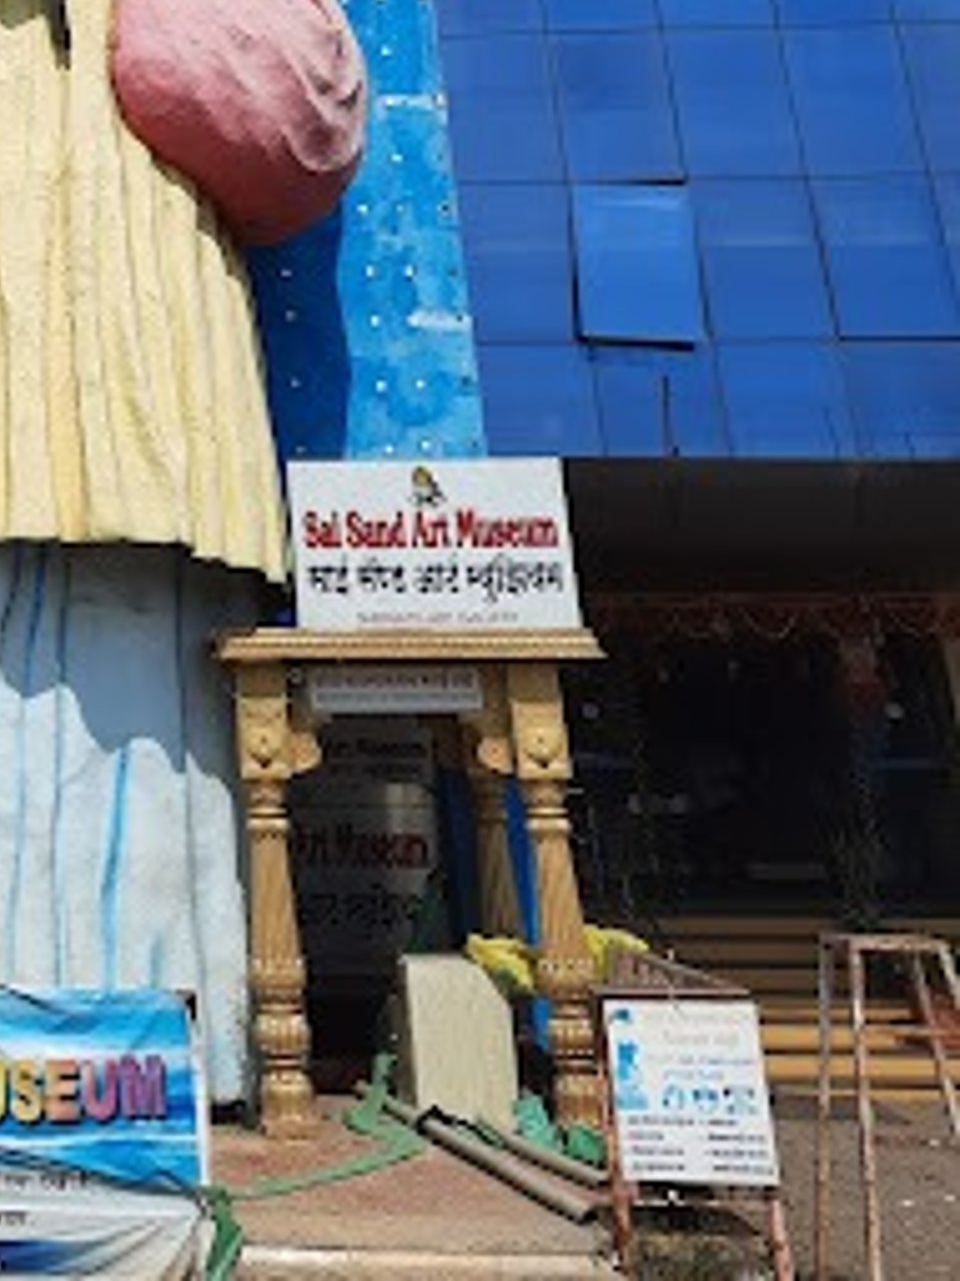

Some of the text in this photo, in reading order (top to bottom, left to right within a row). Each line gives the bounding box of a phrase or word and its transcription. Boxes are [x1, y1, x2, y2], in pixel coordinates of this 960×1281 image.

[302, 508, 558, 548] Sai Sand Art Museum
